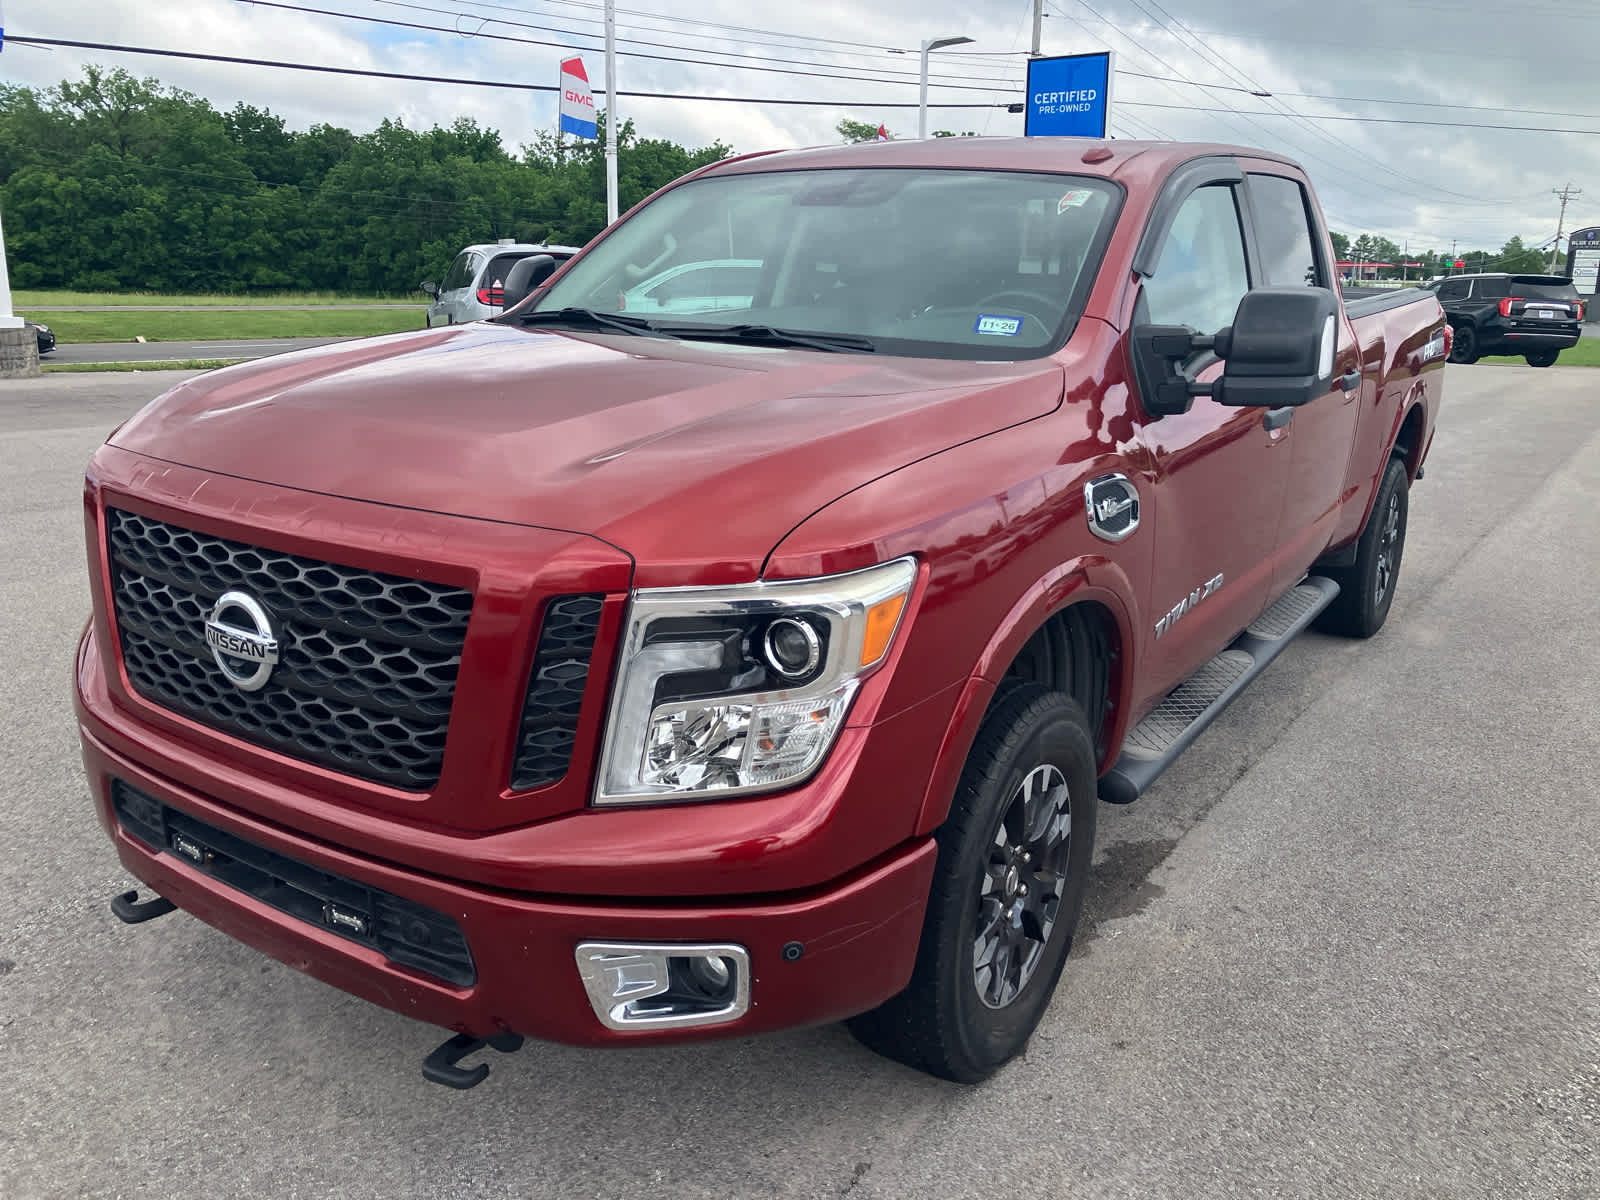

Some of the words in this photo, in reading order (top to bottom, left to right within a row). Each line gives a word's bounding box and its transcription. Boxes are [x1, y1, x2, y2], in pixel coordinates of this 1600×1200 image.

[565, 90, 594, 108] GMC
[1034, 89, 1097, 105] CERTIFIED
[1039, 103, 1091, 115] PRE-OWNED
[1155, 588, 1201, 641] TITAN
[206, 628, 266, 658] NISSAN
